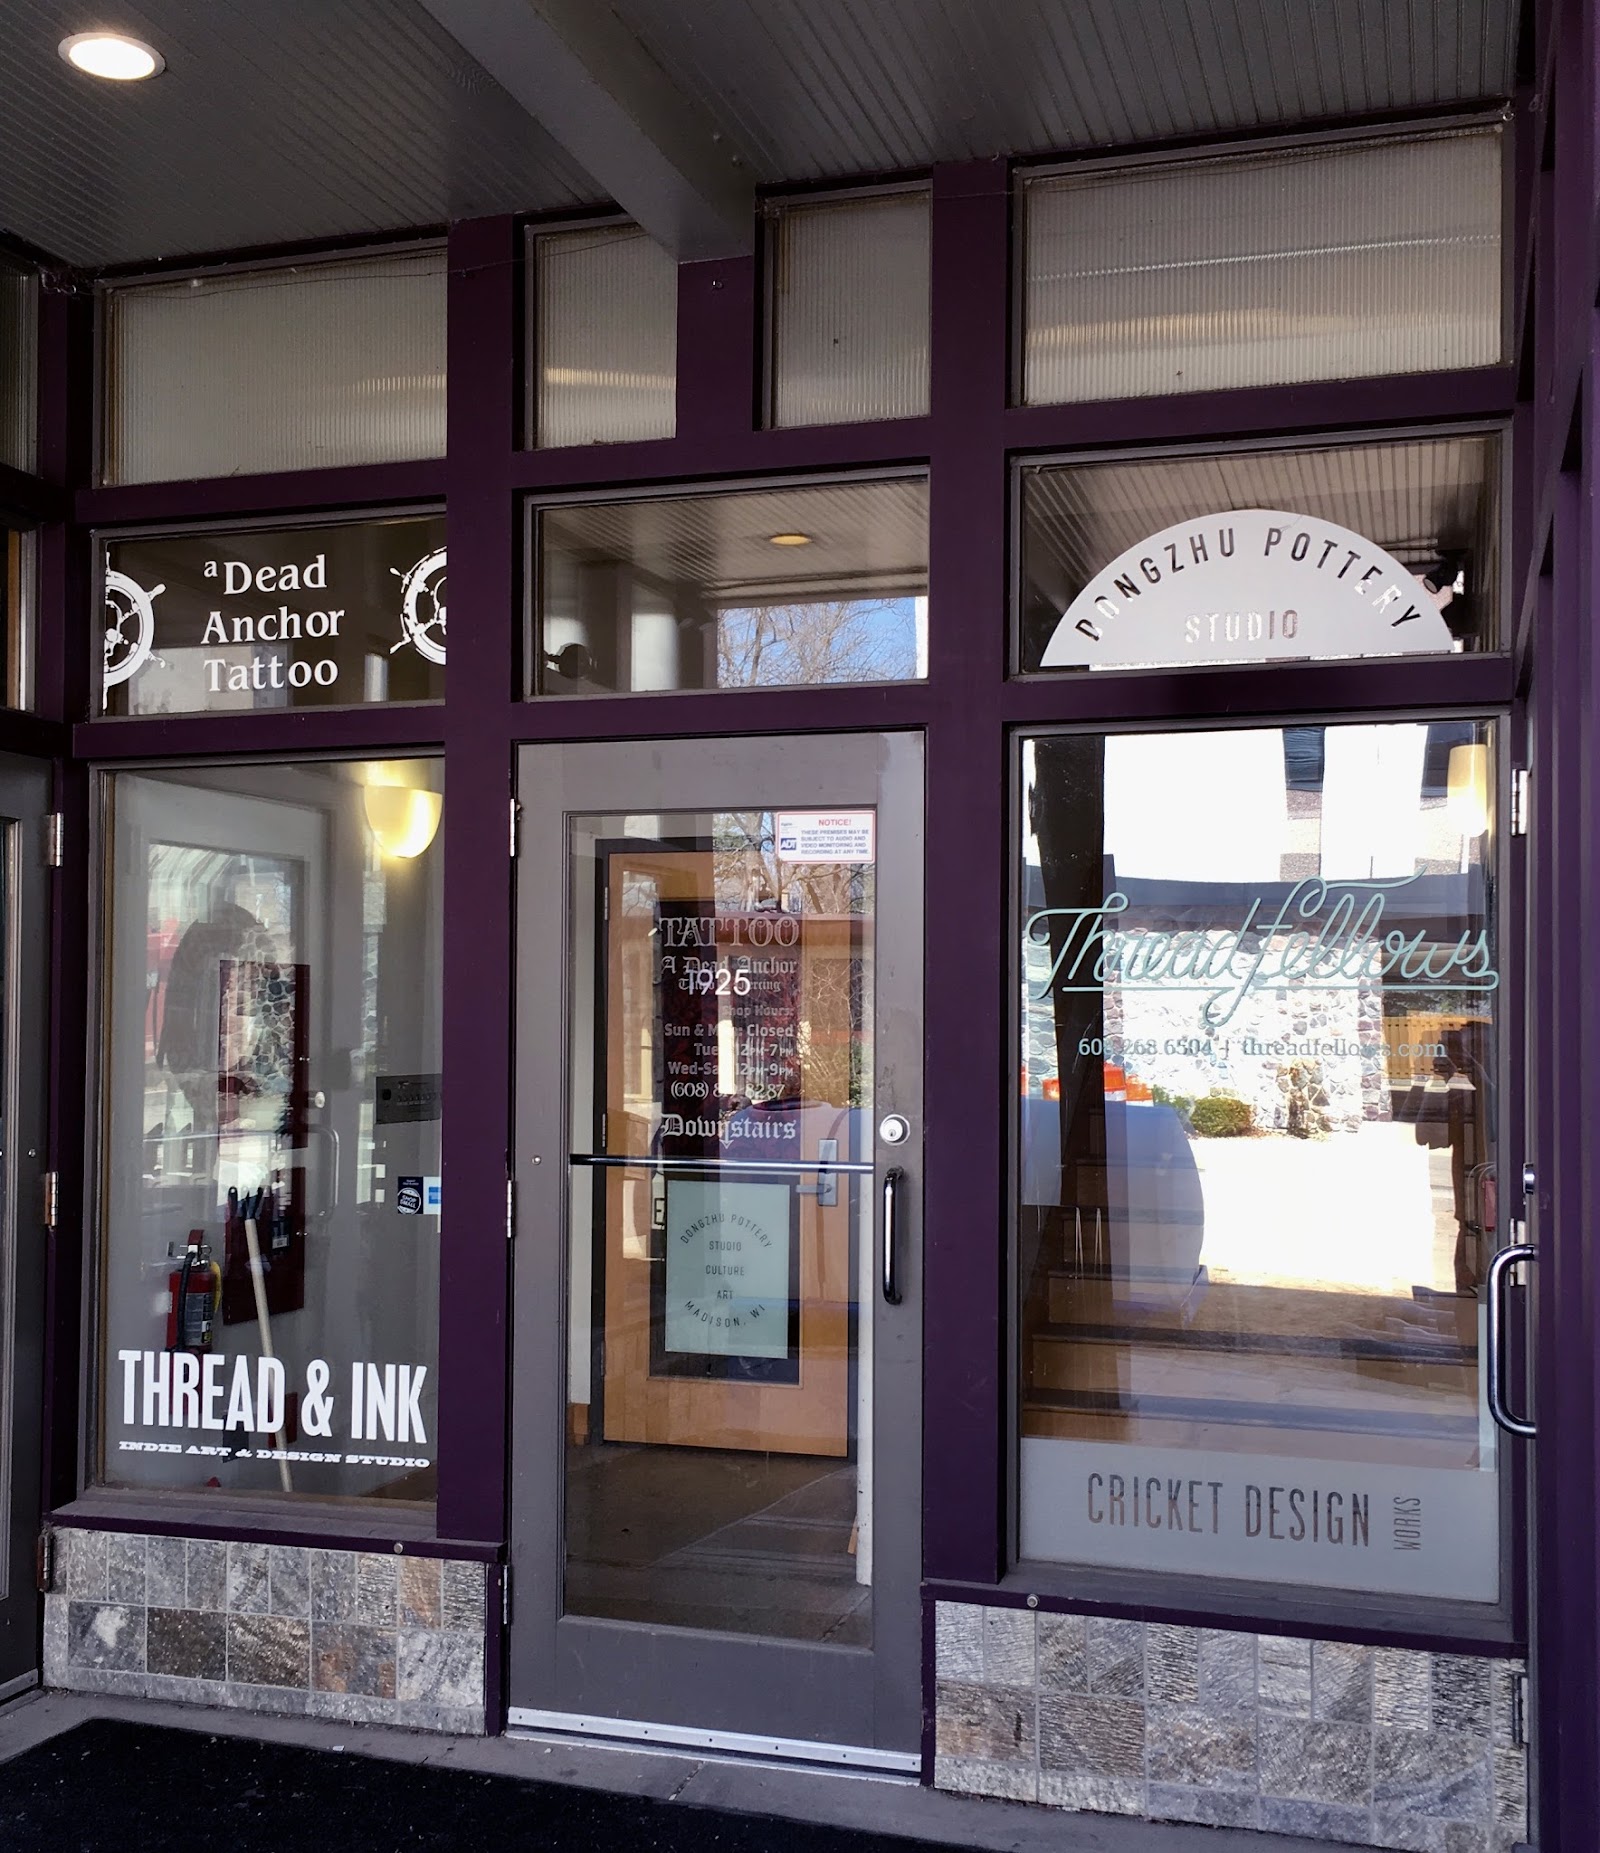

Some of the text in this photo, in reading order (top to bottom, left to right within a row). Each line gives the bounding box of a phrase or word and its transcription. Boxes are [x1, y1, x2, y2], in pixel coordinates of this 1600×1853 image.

[204, 554, 327, 595] a Dead
[1075, 527, 1421, 642] DONGZHU POTTERY
[200, 606, 345, 645] Anchor
[1184, 608, 1299, 643] STUDIO
[203, 656, 338, 692] Tattoo
[818, 818, 851, 826] NOTICE!
[781, 838, 796, 850] ADT
[659, 916, 800, 947] TATTOO
[661, 955, 798, 979] A Dead Anchor
[686, 968, 751, 996] 1925
[664, 1023, 690, 1036] Sun
[694, 1023, 704, 1036] &
[747, 1024, 794, 1037] Closed
[671, 1080, 709, 1099] (608)
[660, 1114, 797, 1146] Downstairs
[680, 1213, 772, 1248] DONGZHU POTTERY
[709, 1240, 742, 1251] STUDIO
[705, 1264, 745, 1276] CULTURE
[717, 1290, 733, 1299] ART
[750, 1304, 766, 1319] WI
[118, 1350, 427, 1444] THREAD & INK
[119, 1441, 430, 1467] INDIE ART & DESIGN STUDIO
[1088, 1472, 1421, 1551] CRICKET DESIGN WORKS
